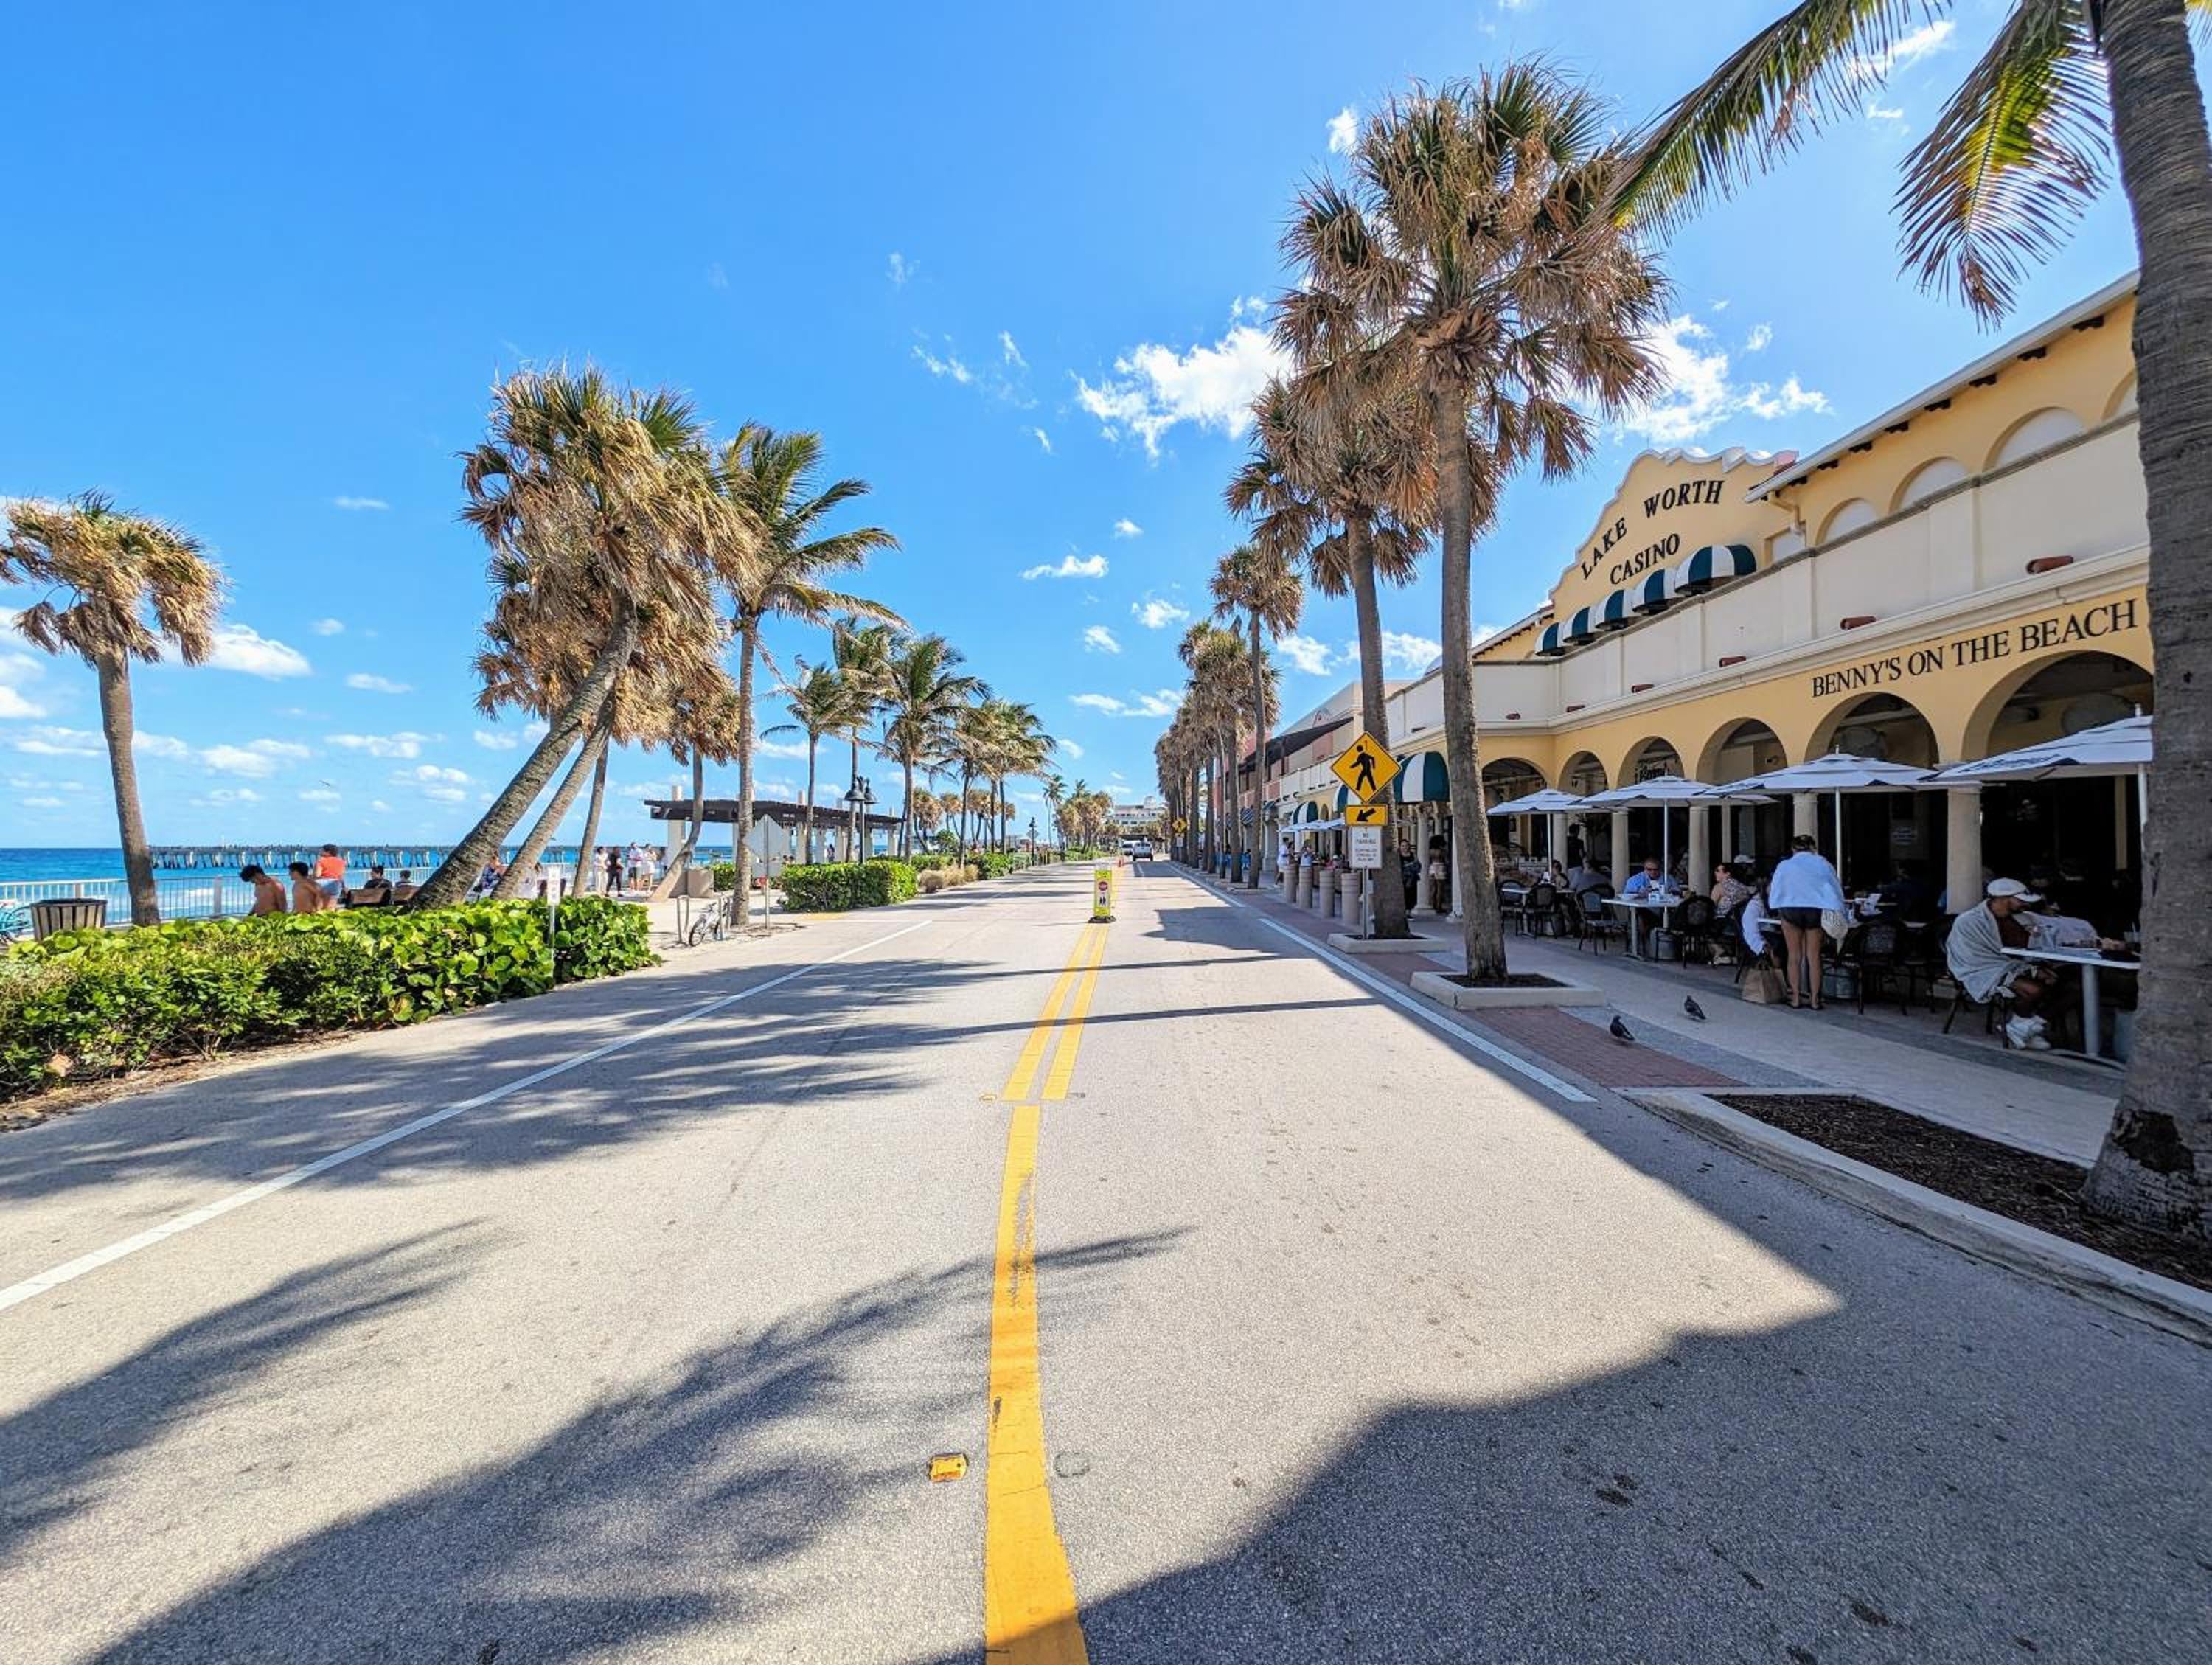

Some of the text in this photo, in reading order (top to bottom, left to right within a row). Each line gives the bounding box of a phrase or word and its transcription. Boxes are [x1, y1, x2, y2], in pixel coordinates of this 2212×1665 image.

[1581, 480, 1725, 580] LAKE WORTH
[1610, 533, 1680, 585] CASINO
[1812, 599, 2138, 698] BENNY'S ON THE BEACH
